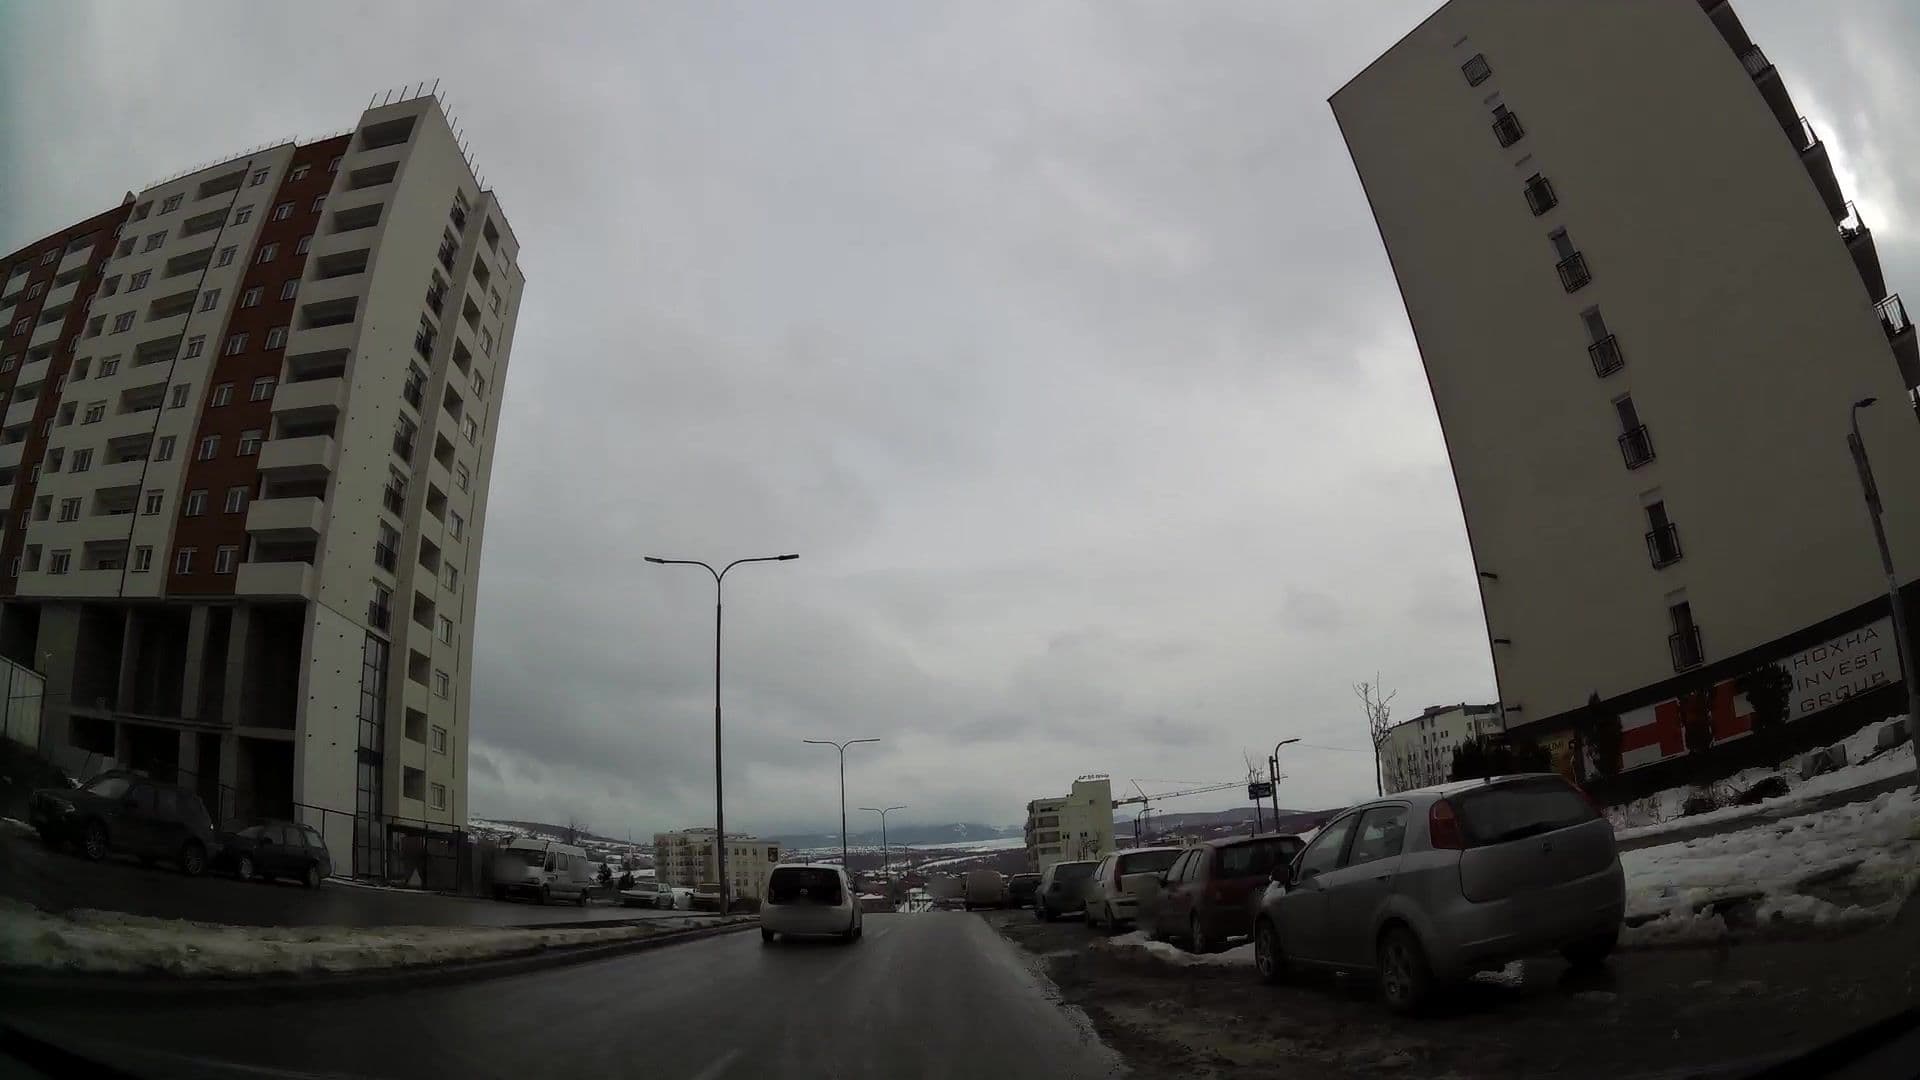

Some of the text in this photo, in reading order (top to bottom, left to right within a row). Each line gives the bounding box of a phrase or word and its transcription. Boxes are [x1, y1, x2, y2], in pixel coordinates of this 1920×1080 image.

[1794, 628, 1878, 669] HOXHA
[1797, 648, 1882, 691] INVEST
[1801, 672, 1884, 712] GROUP
